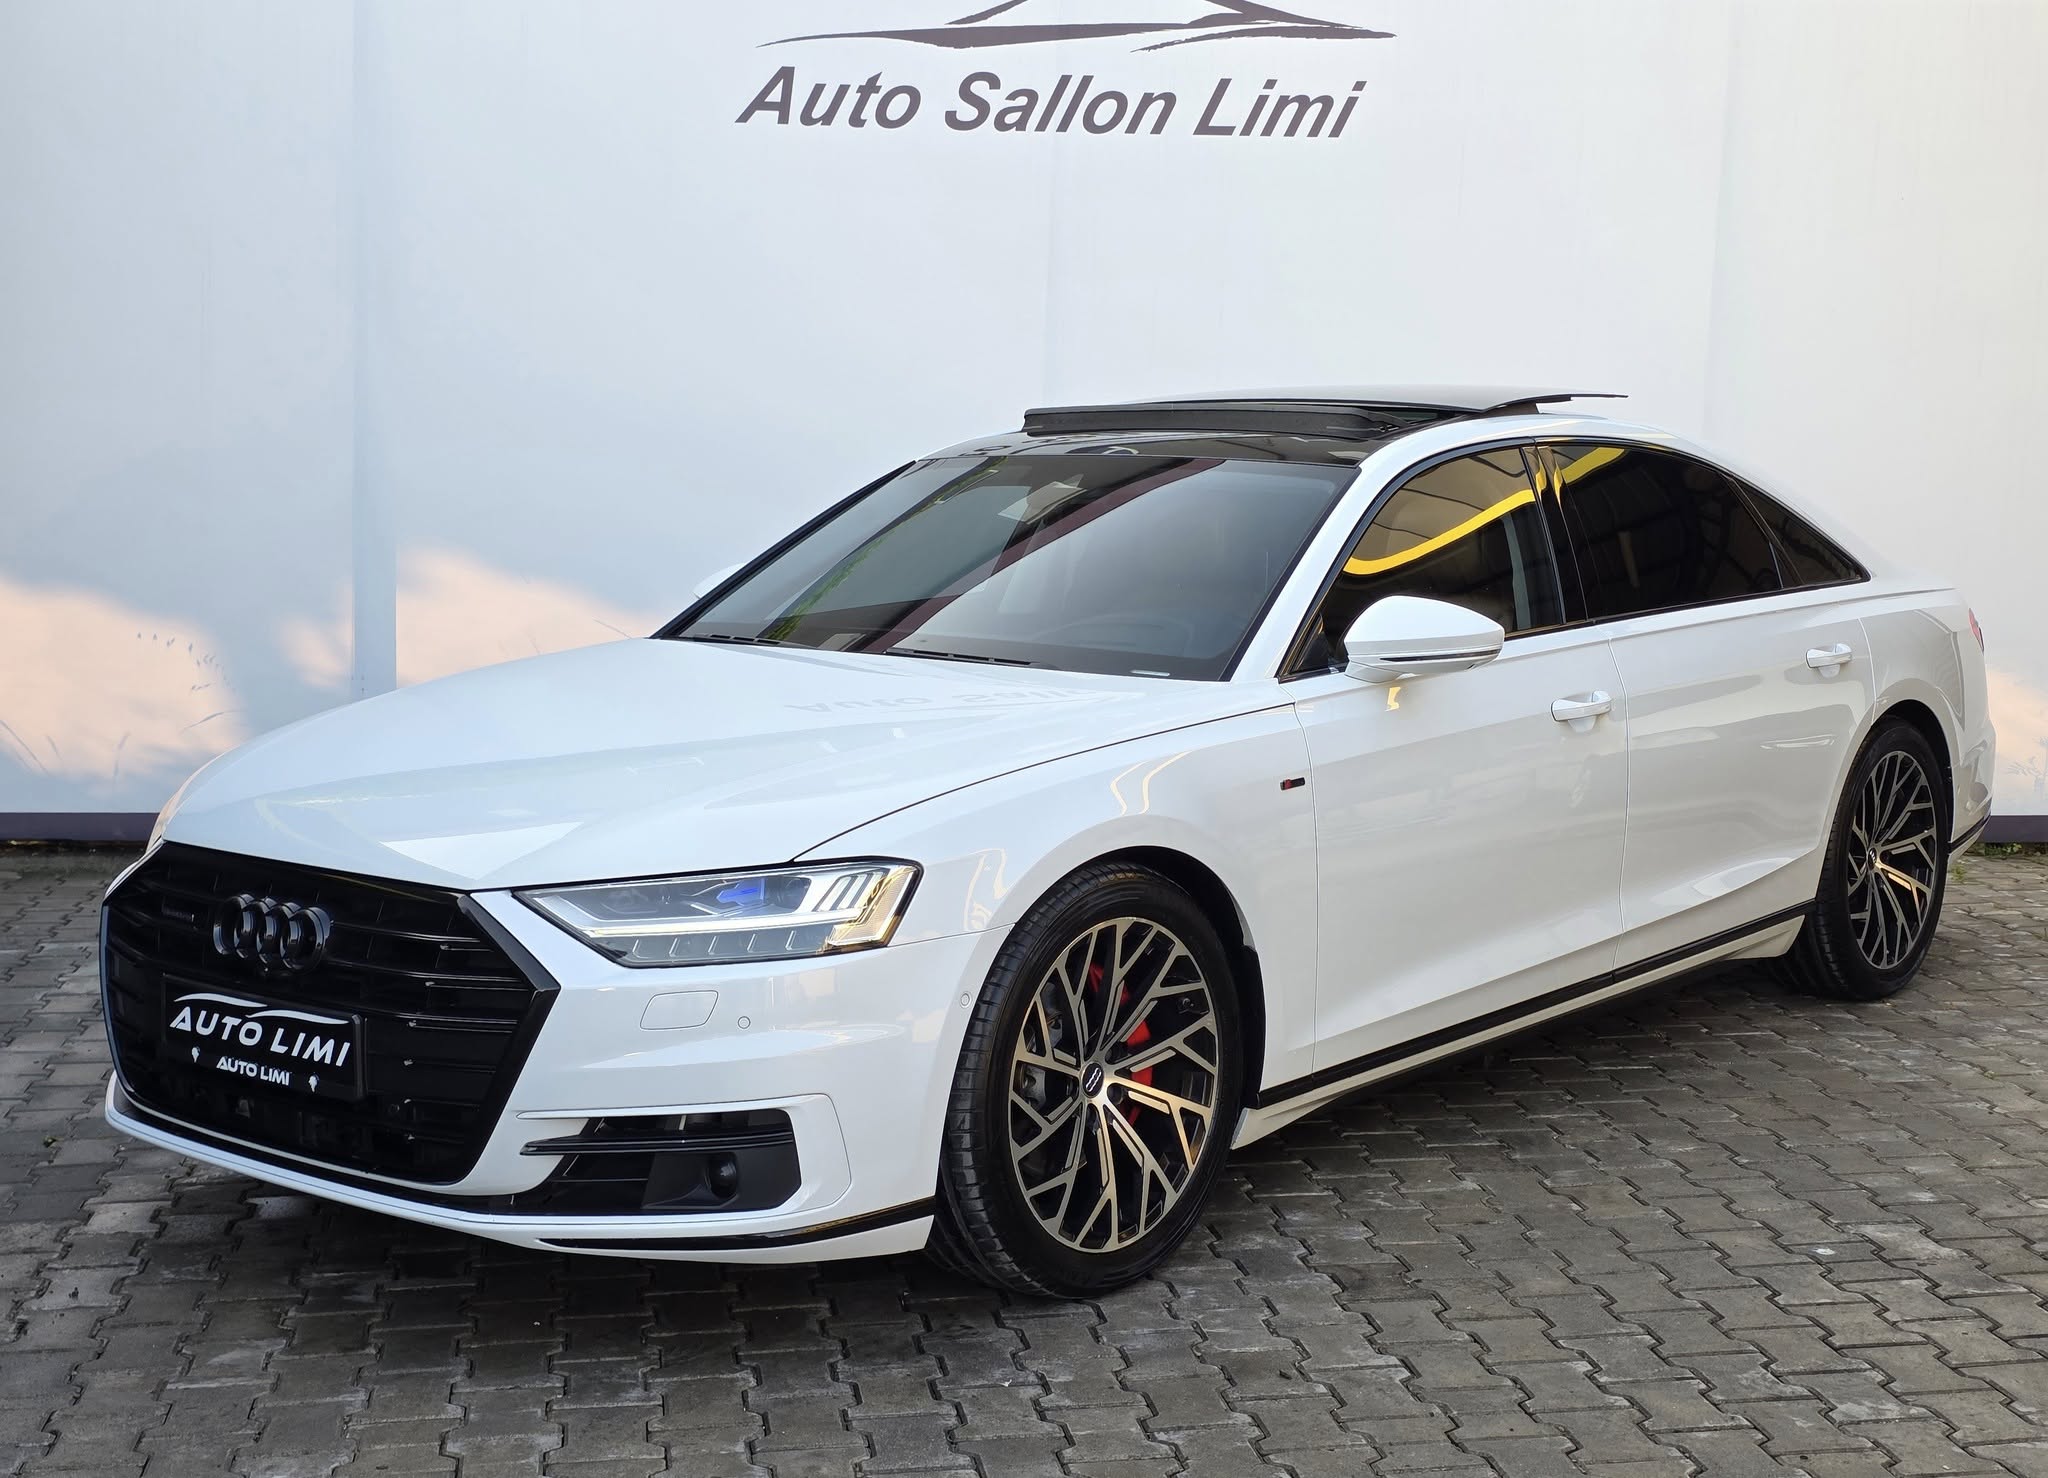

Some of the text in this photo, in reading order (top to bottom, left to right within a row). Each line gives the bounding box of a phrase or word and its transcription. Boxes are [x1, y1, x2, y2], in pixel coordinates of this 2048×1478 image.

[734, 65, 1368, 138] Auto Sallon Limi
[169, 1006, 351, 1067] AUTO LIMI
[216, 1056, 290, 1086] AUTO LIMI
